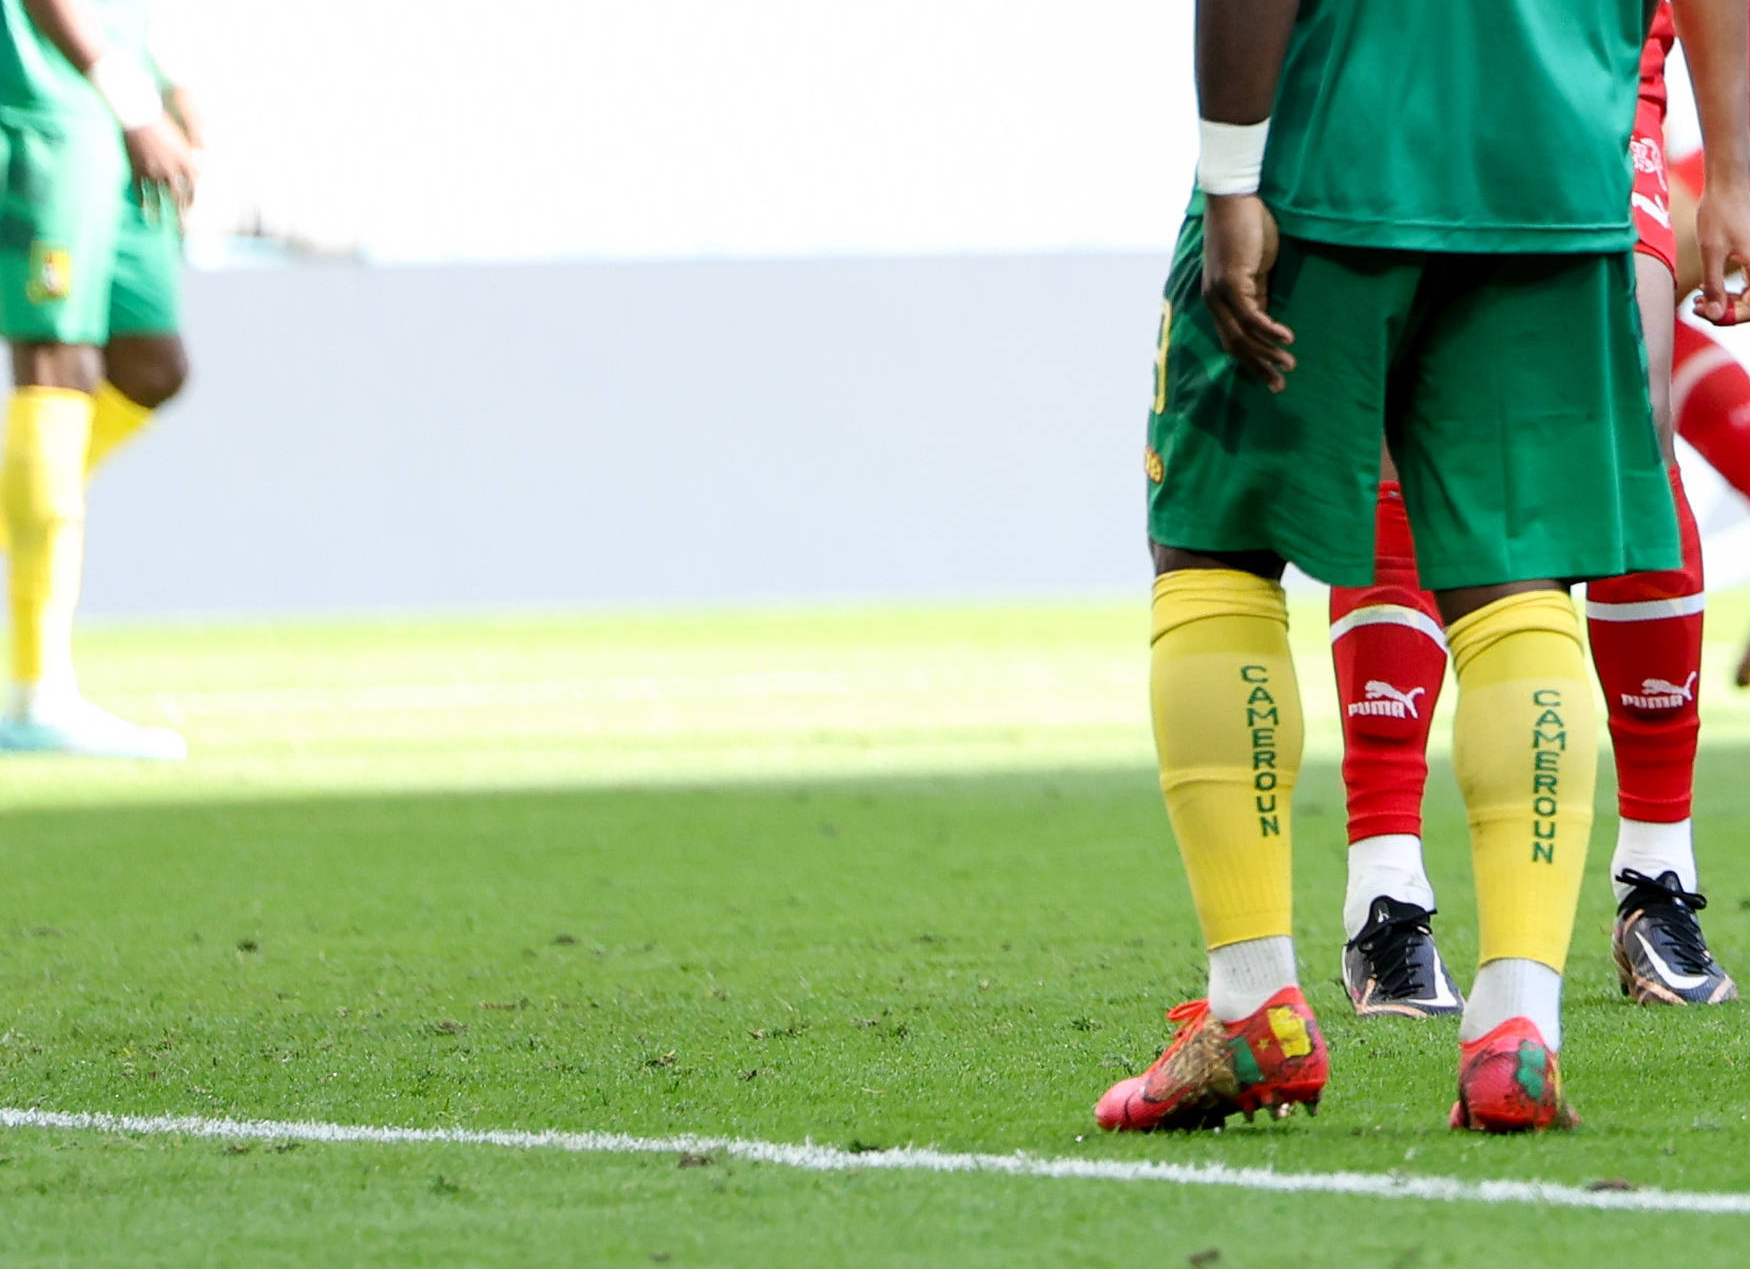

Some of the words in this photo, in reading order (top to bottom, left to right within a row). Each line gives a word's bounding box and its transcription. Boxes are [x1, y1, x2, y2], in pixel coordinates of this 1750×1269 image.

[1347, 699, 1406, 719] PUMA
[1620, 692, 1684, 710] PUMA
[1240, 664, 1280, 838] CAMEROUN
[1531, 689, 1567, 865] CAMEROUN
